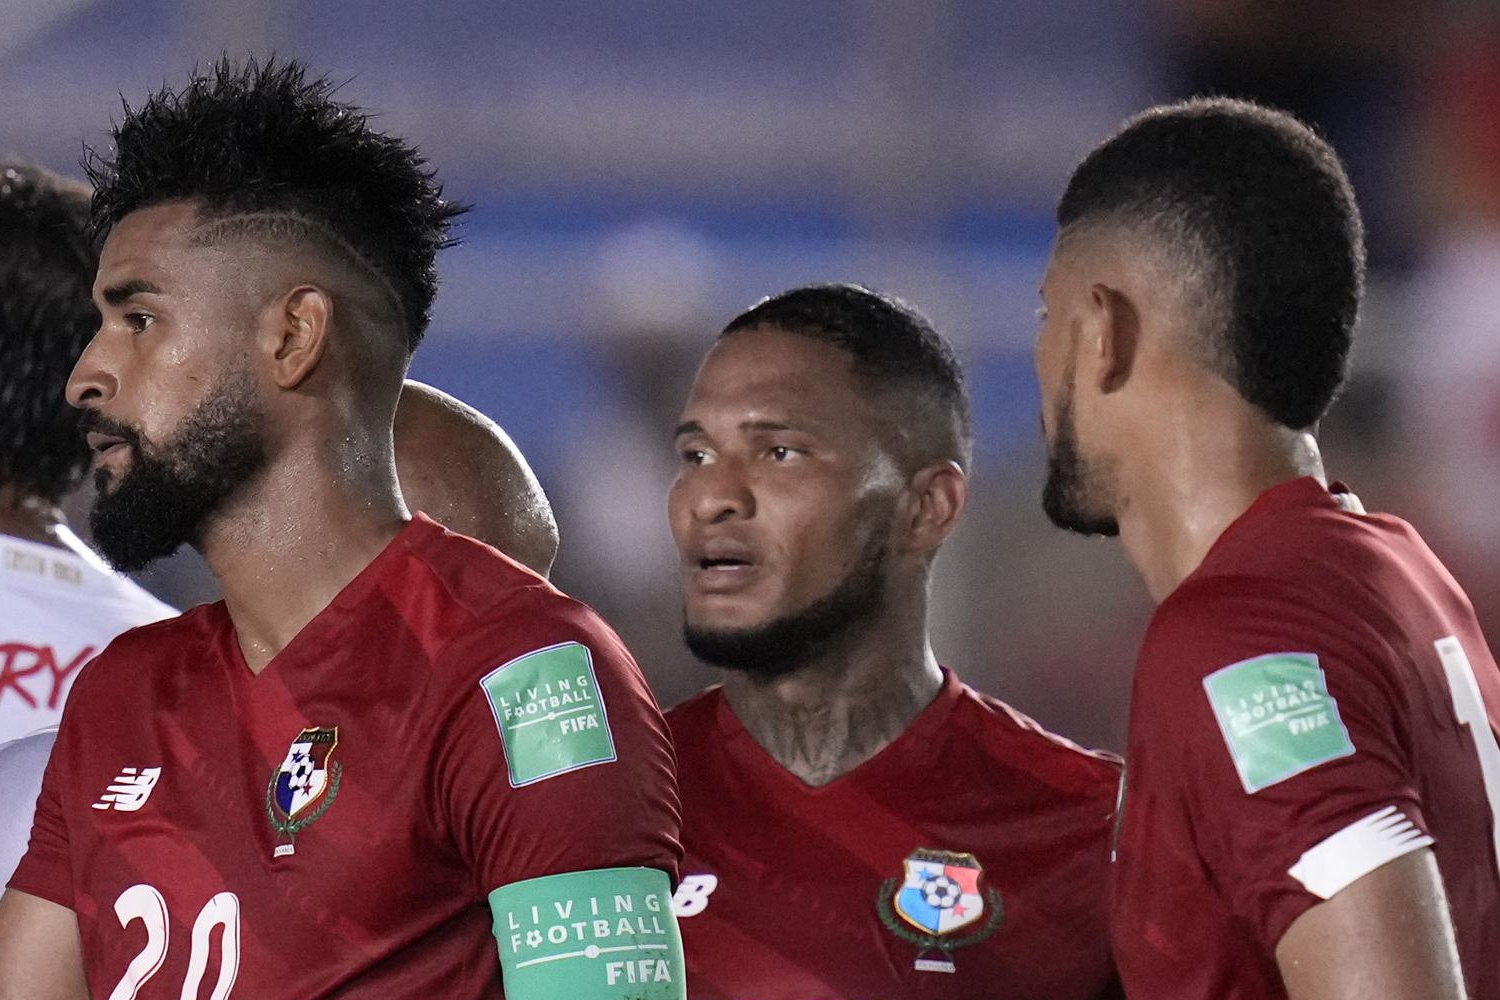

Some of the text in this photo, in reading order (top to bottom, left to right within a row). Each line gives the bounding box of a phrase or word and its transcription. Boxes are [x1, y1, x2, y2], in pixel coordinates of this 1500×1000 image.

[500, 675, 589, 708] LIVING
[503, 688, 592, 721] FOOTBALL
[560, 714, 599, 736] FIFA
[507, 893, 661, 931] LIVING
[672, 873, 718, 918] B
[510, 916, 666, 953] FOOTBALL
[605, 959, 672, 986] FIFA
